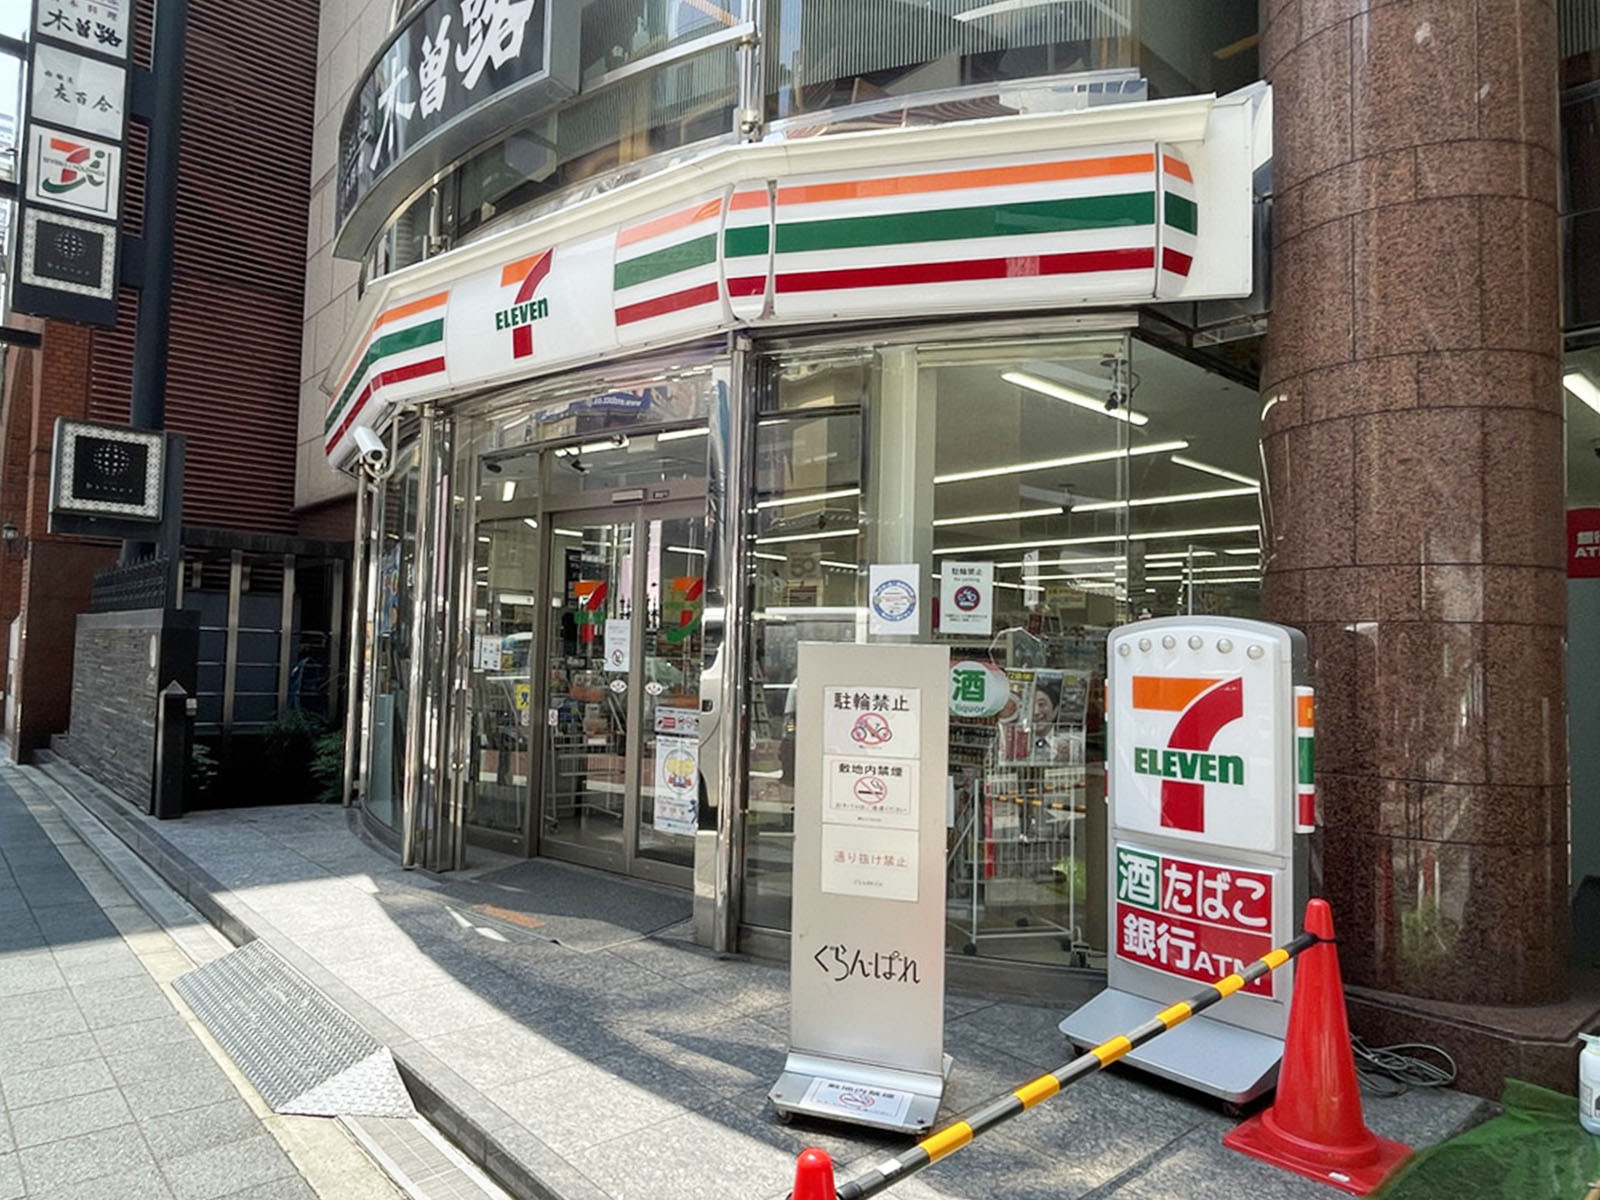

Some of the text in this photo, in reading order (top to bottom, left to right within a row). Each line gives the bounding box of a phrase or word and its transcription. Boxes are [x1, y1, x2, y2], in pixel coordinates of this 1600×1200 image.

[1573, 546, 1600, 558] AT
[951, 669, 987, 702] 酒
[833, 692, 910, 711] 駐輪禁止
[838, 762, 903, 777] 敷地内禁煙
[833, 850, 908, 868] 通り抜け禁止
[1118, 853, 1269, 927] 酒 たばこ
